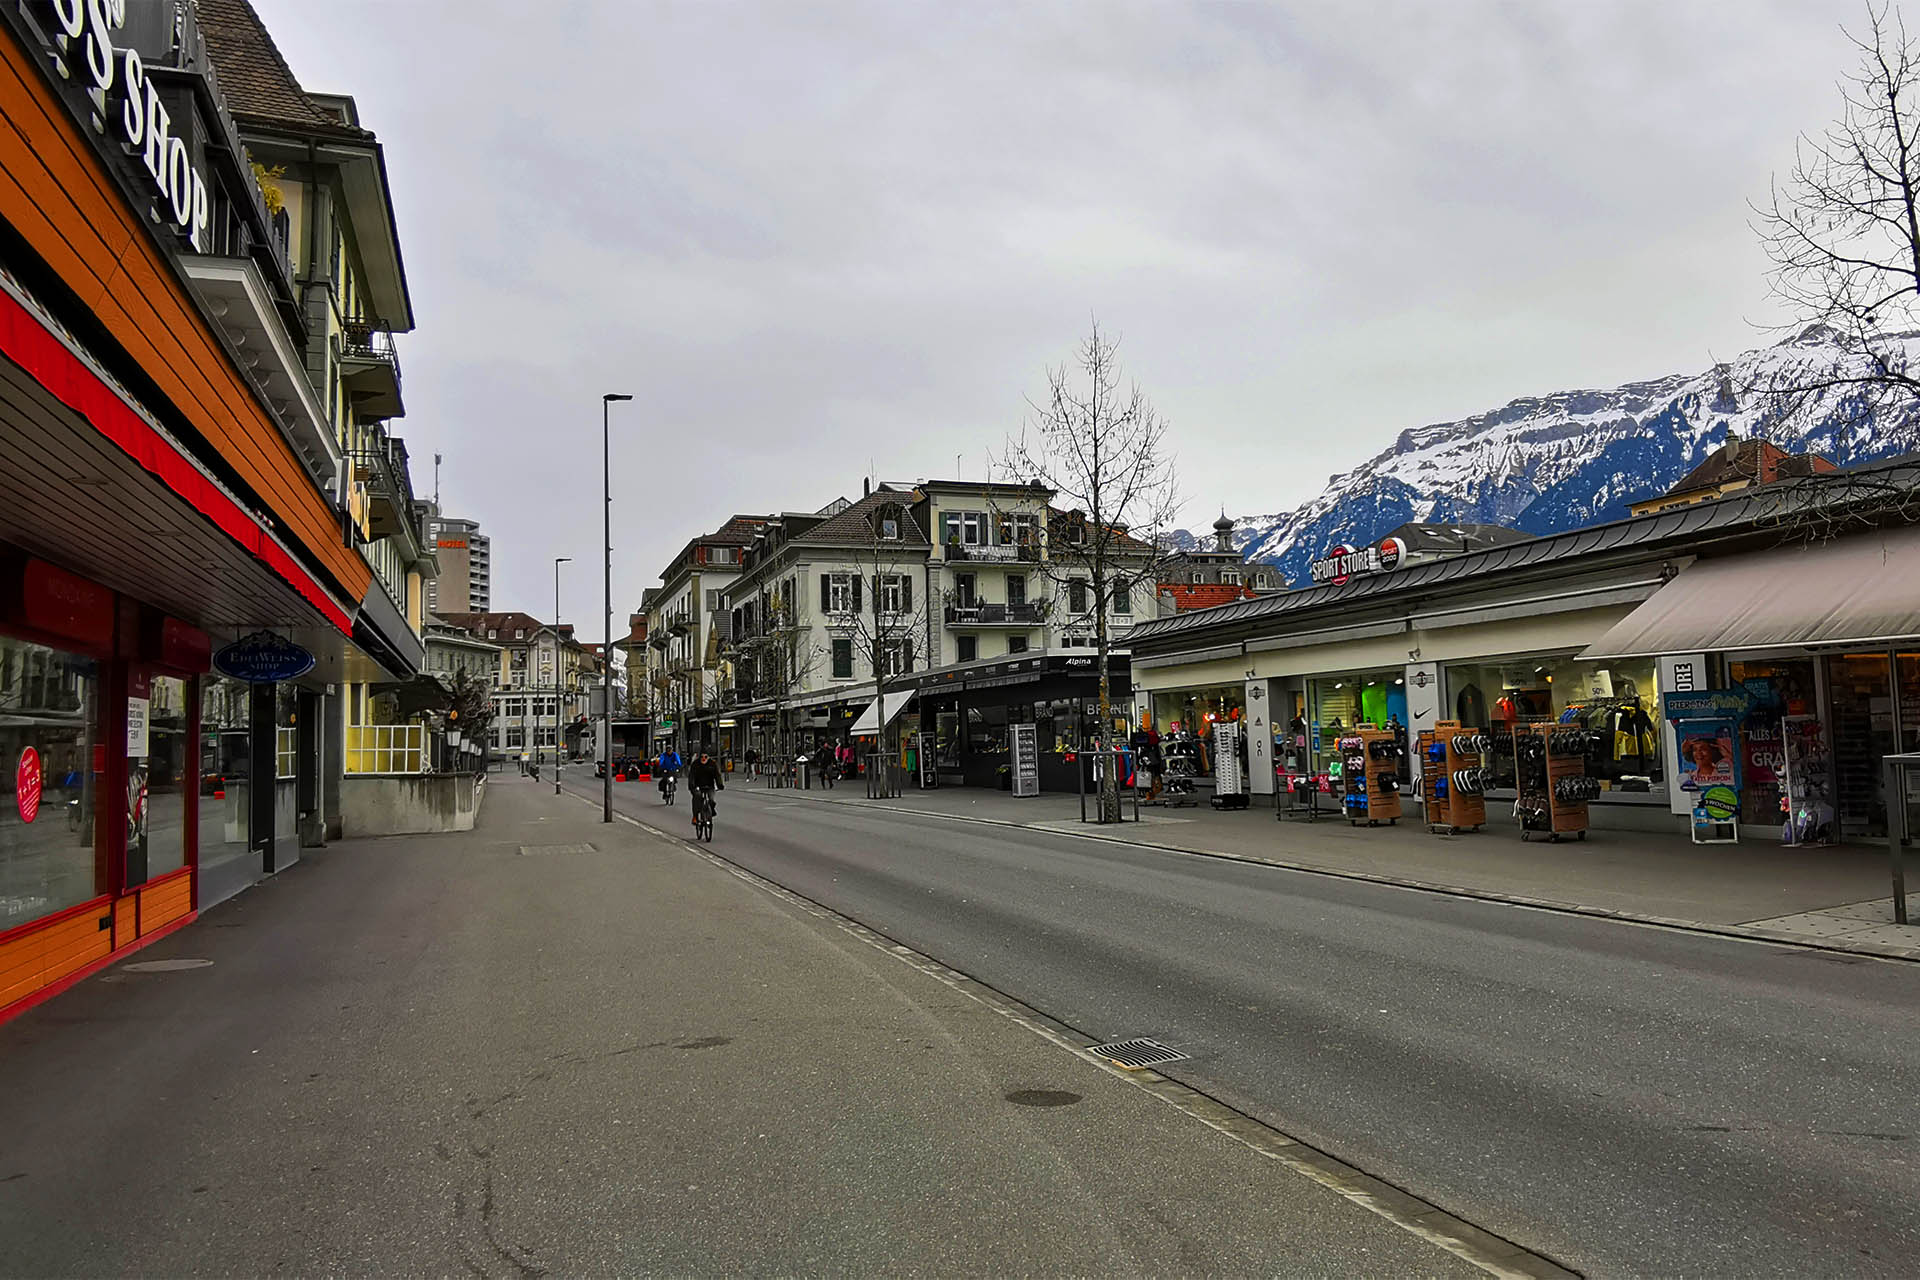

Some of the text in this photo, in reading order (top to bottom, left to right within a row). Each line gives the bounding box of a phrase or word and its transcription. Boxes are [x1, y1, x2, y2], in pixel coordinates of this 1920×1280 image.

[124, 48, 208, 254] SHOP
[1312, 550, 1370, 581] SPORT STORE
[1065, 657, 1092, 666] Alpina
